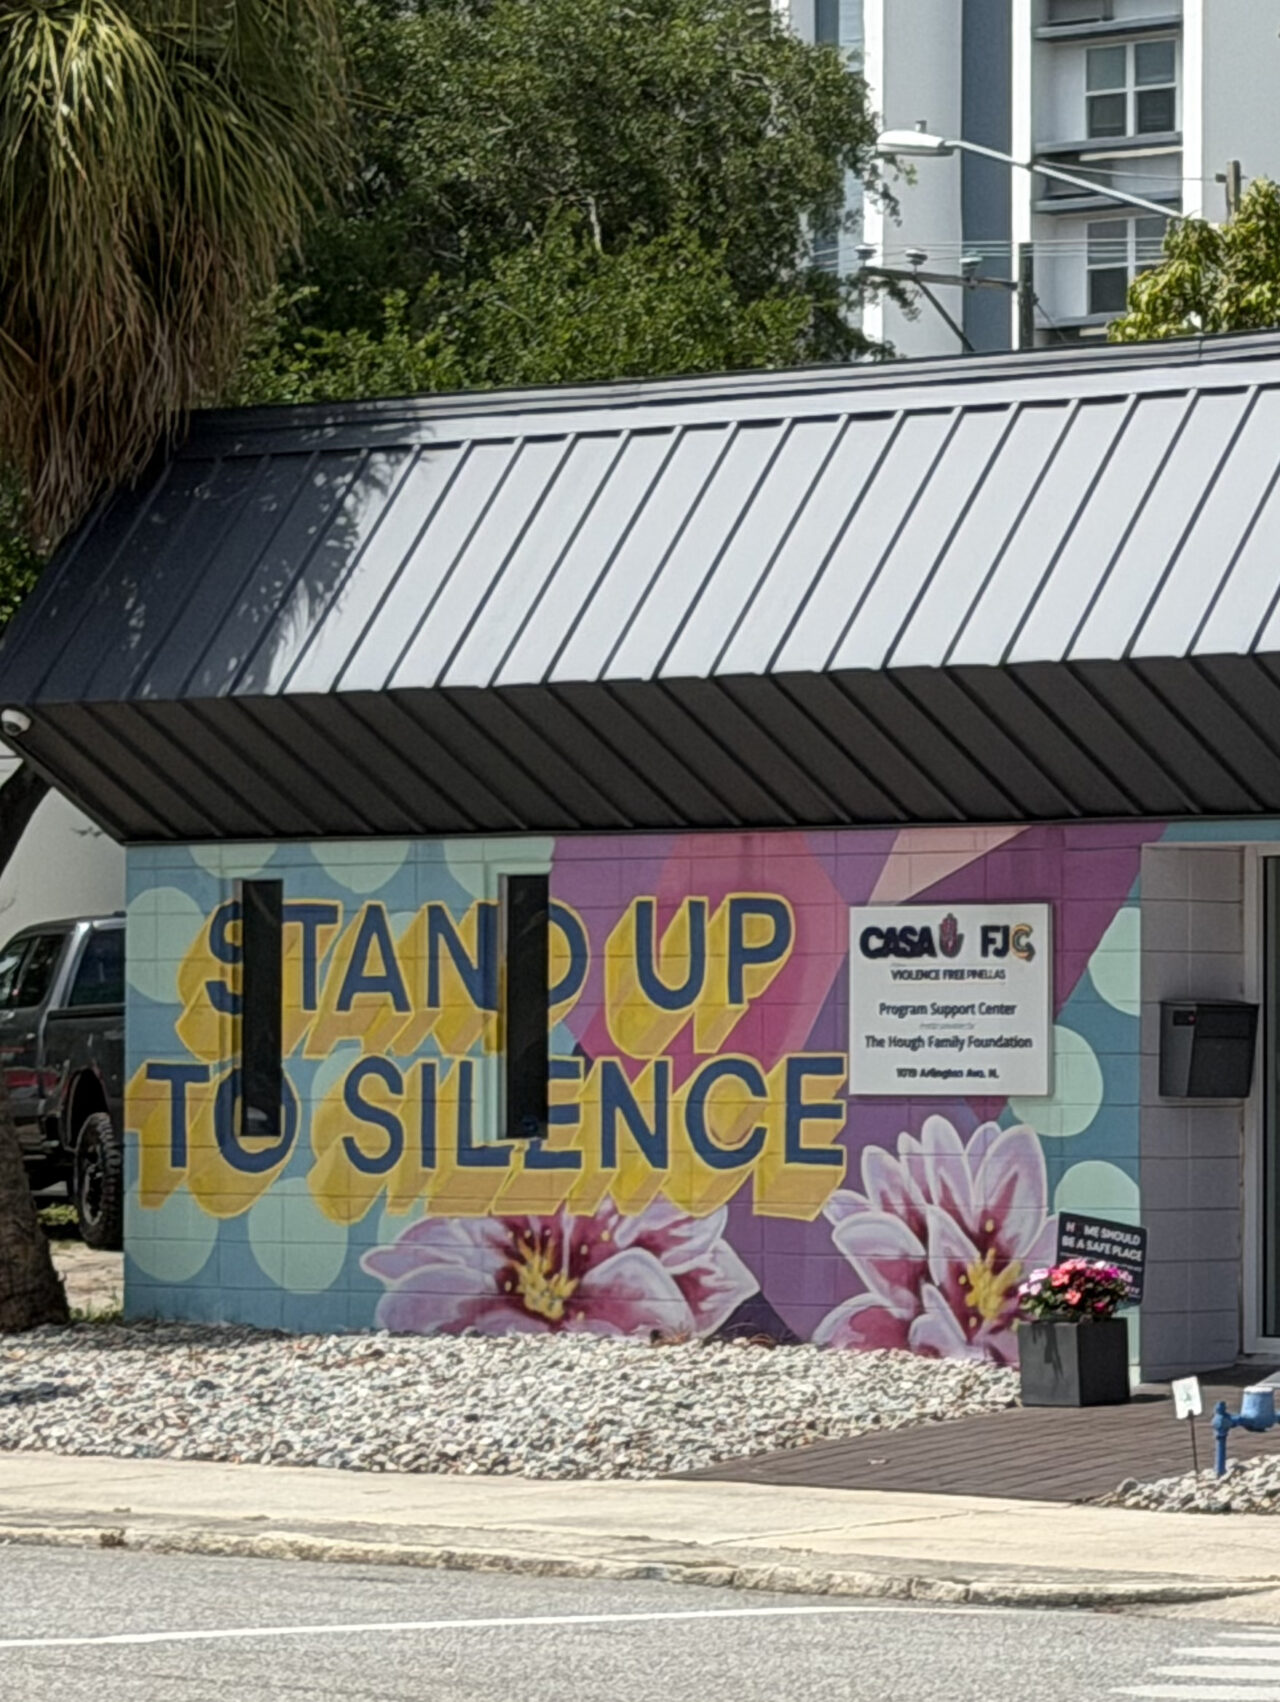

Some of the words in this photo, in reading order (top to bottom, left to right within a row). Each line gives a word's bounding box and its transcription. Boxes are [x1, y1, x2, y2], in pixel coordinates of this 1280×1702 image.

[859, 925, 938, 959] CASA
[980, 923, 1036, 962] FJC
[204, 901, 588, 1014] STAND
[634, 896, 796, 1010] UP
[891, 969, 940, 980] VIOLENCE
[943, 969, 965, 980] FREE
[966, 969, 1006, 980] PINELLAS
[878, 1002, 928, 1019] Program
[930, 1002, 976, 1018] Support
[978, 1002, 1017, 1015] Center
[865, 1035, 886, 1048] The
[888, 1035, 925, 1051] Hough
[928, 1035, 965, 1052] Family
[967, 1034, 1033, 1048] Foundation
[920, 1067, 964, 1079] Arlington
[147, 1061, 294, 1173] TO
[342, 1057, 847, 1175] SILENCE
[1065, 1222, 1100, 1238] HME
[1100, 1227, 1141, 1246] SHOULD
[1061, 1235, 1076, 1248] BE
[1076, 1239, 1085, 1249] A
[1086, 1241, 1112, 1255] SAFE
[1112, 1245, 1143, 1262] PLACE
